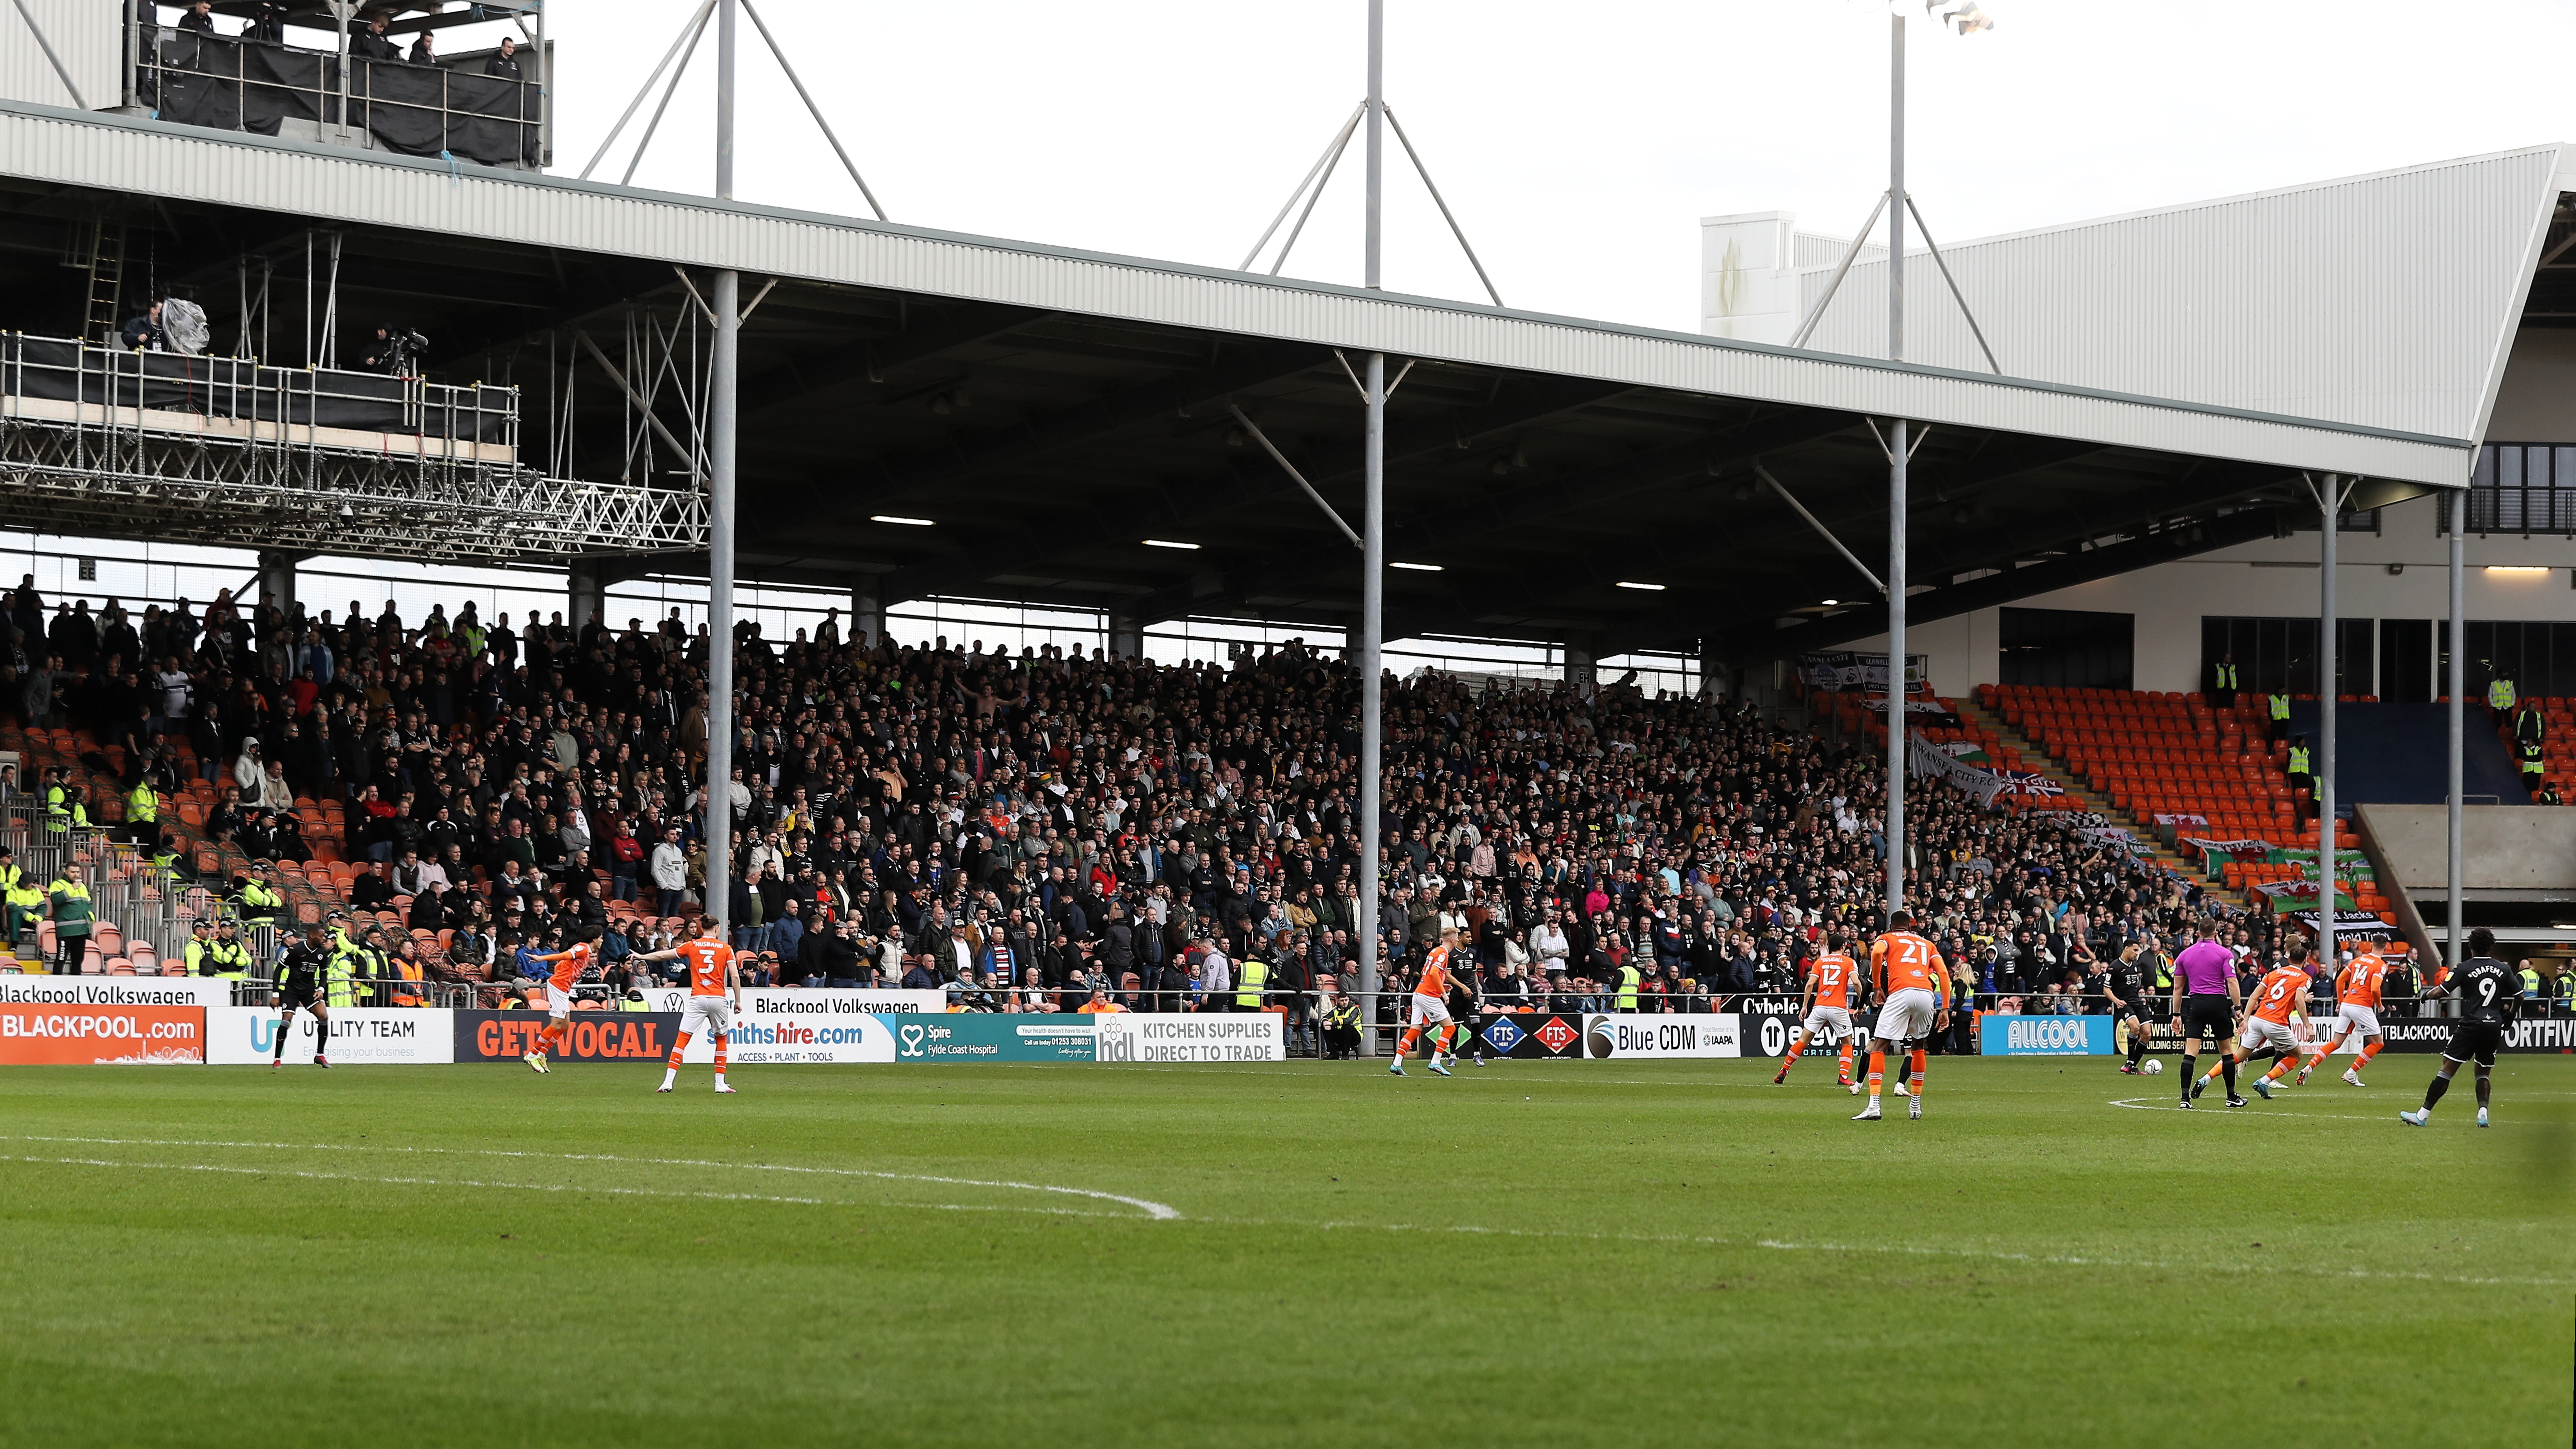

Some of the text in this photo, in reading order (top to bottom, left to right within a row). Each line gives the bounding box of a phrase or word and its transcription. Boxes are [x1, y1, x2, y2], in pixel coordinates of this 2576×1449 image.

[81, 567, 95, 580] EE
[1580, 673, 1590, 683] EH
[1913, 739, 1953, 775] SWANSEA
[1955, 769, 1977, 784] CITY
[2343, 910, 2374, 919] Jacks
[1897, 938, 1928, 966] 21
[698, 949, 715, 974] 3
[1821, 964, 1842, 985] 12
[2276, 969, 2302, 977] STEWART
[2352, 963, 2368, 986] 14
[2471, 967, 2504, 978] OBAFEMI
[86, 986, 195, 1005] Volkswagen
[2270, 978, 2287, 1000] 6
[2478, 978, 2496, 1007] 9
[756, 998, 919, 1014] Blackpool Volkswagen
[0, 1015, 195, 1039] BLACKPOOL.com
[303, 1021, 415, 1038] ULITY TEAM
[928, 1024, 952, 1042] Spire
[1143, 1023, 1271, 1039] KITCHEN SUPPLIES
[1493, 1027, 1514, 1041] FTS
[1546, 1027, 1567, 1041] FTS
[2008, 1020, 2088, 1049] ALLCOOL
[2316, 1023, 2332, 1043] NO.1
[2381, 1025, 2451, 1040] ITBLACKPOOL
[2501, 1020, 2576, 1048] ORTFIV
[477, 1020, 662, 1058] GET VOCAL
[1052, 1038, 1070, 1046] 01253
[1071, 1038, 1092, 1046] 308031
[1619, 1025, 1696, 1051] Blue CDM
[1712, 1036, 1734, 1045] IAAPA
[2147, 1041, 2171, 1050] UILDING
[303, 1046, 415, 1059] Engising your business
[737, 1053, 833, 1062] ACCESS PLANT TOOLS
[928, 1044, 998, 1057] Fylde Coast Hospital
[1144, 1045, 1272, 1061] DIRECT TO TRADE
